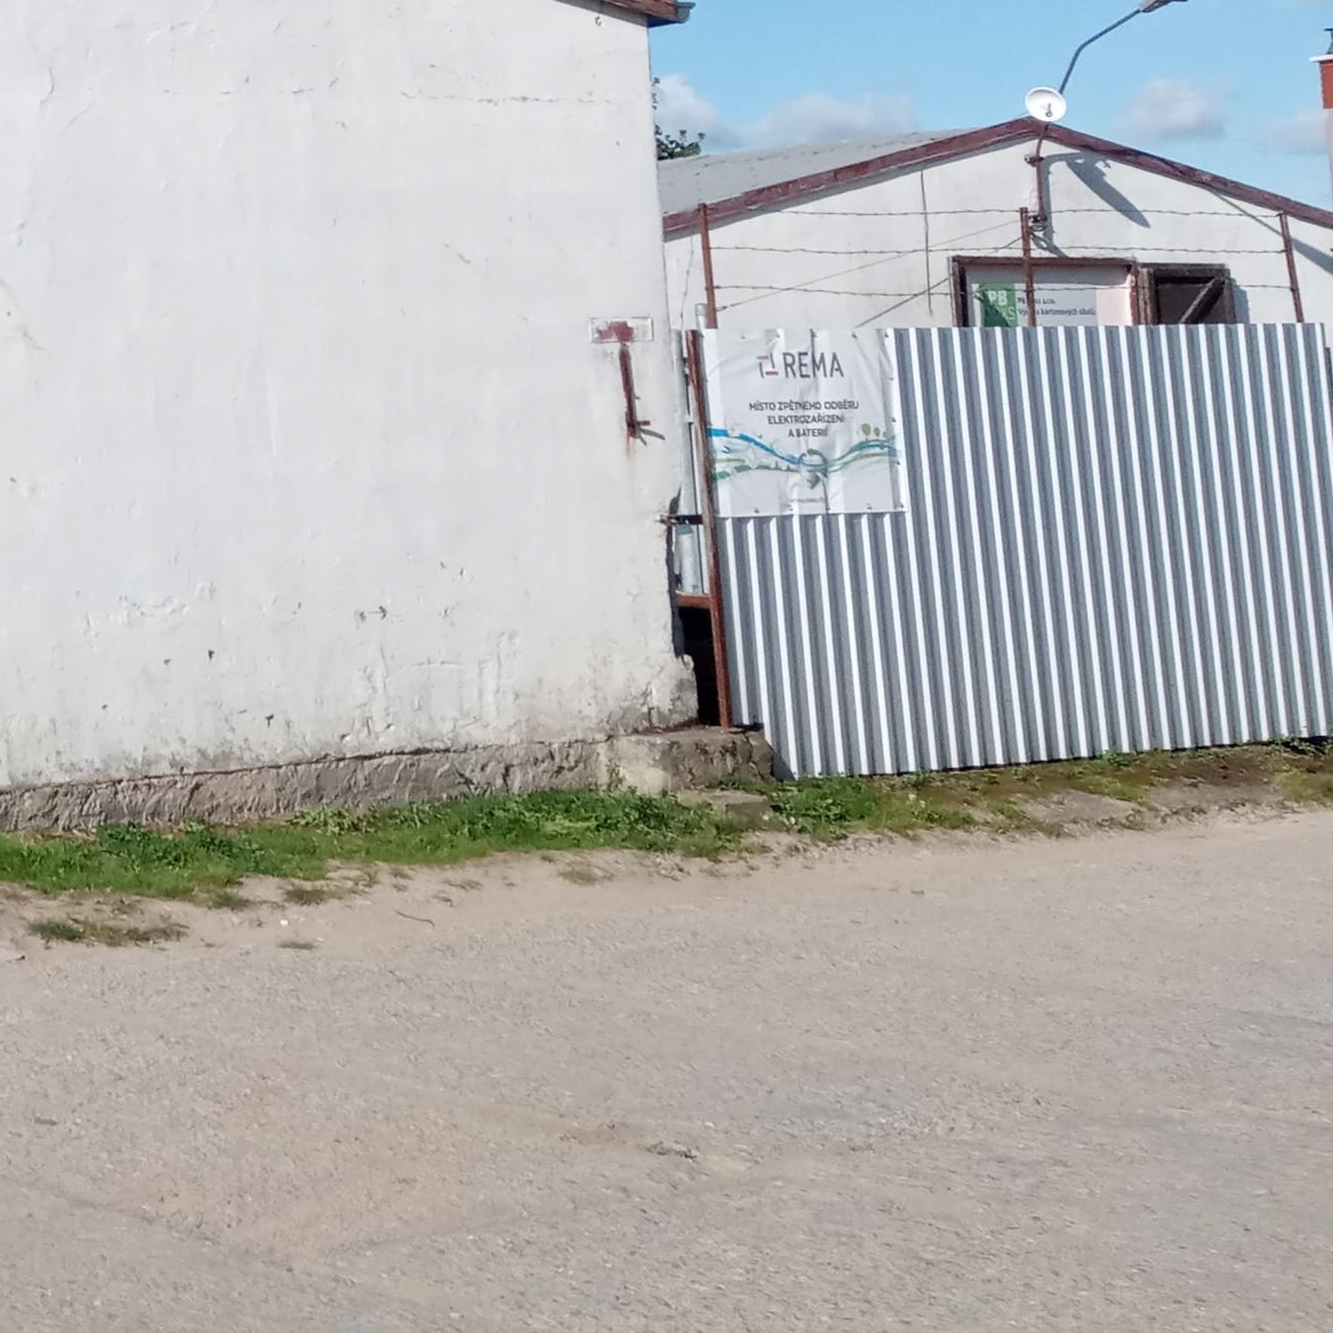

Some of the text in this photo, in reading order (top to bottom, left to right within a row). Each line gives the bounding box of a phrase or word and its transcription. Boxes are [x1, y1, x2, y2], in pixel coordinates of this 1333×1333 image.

[782, 351, 845, 378] REMA
[749, 400, 776, 411] MÍSTO
[788, 428, 795, 438] A
